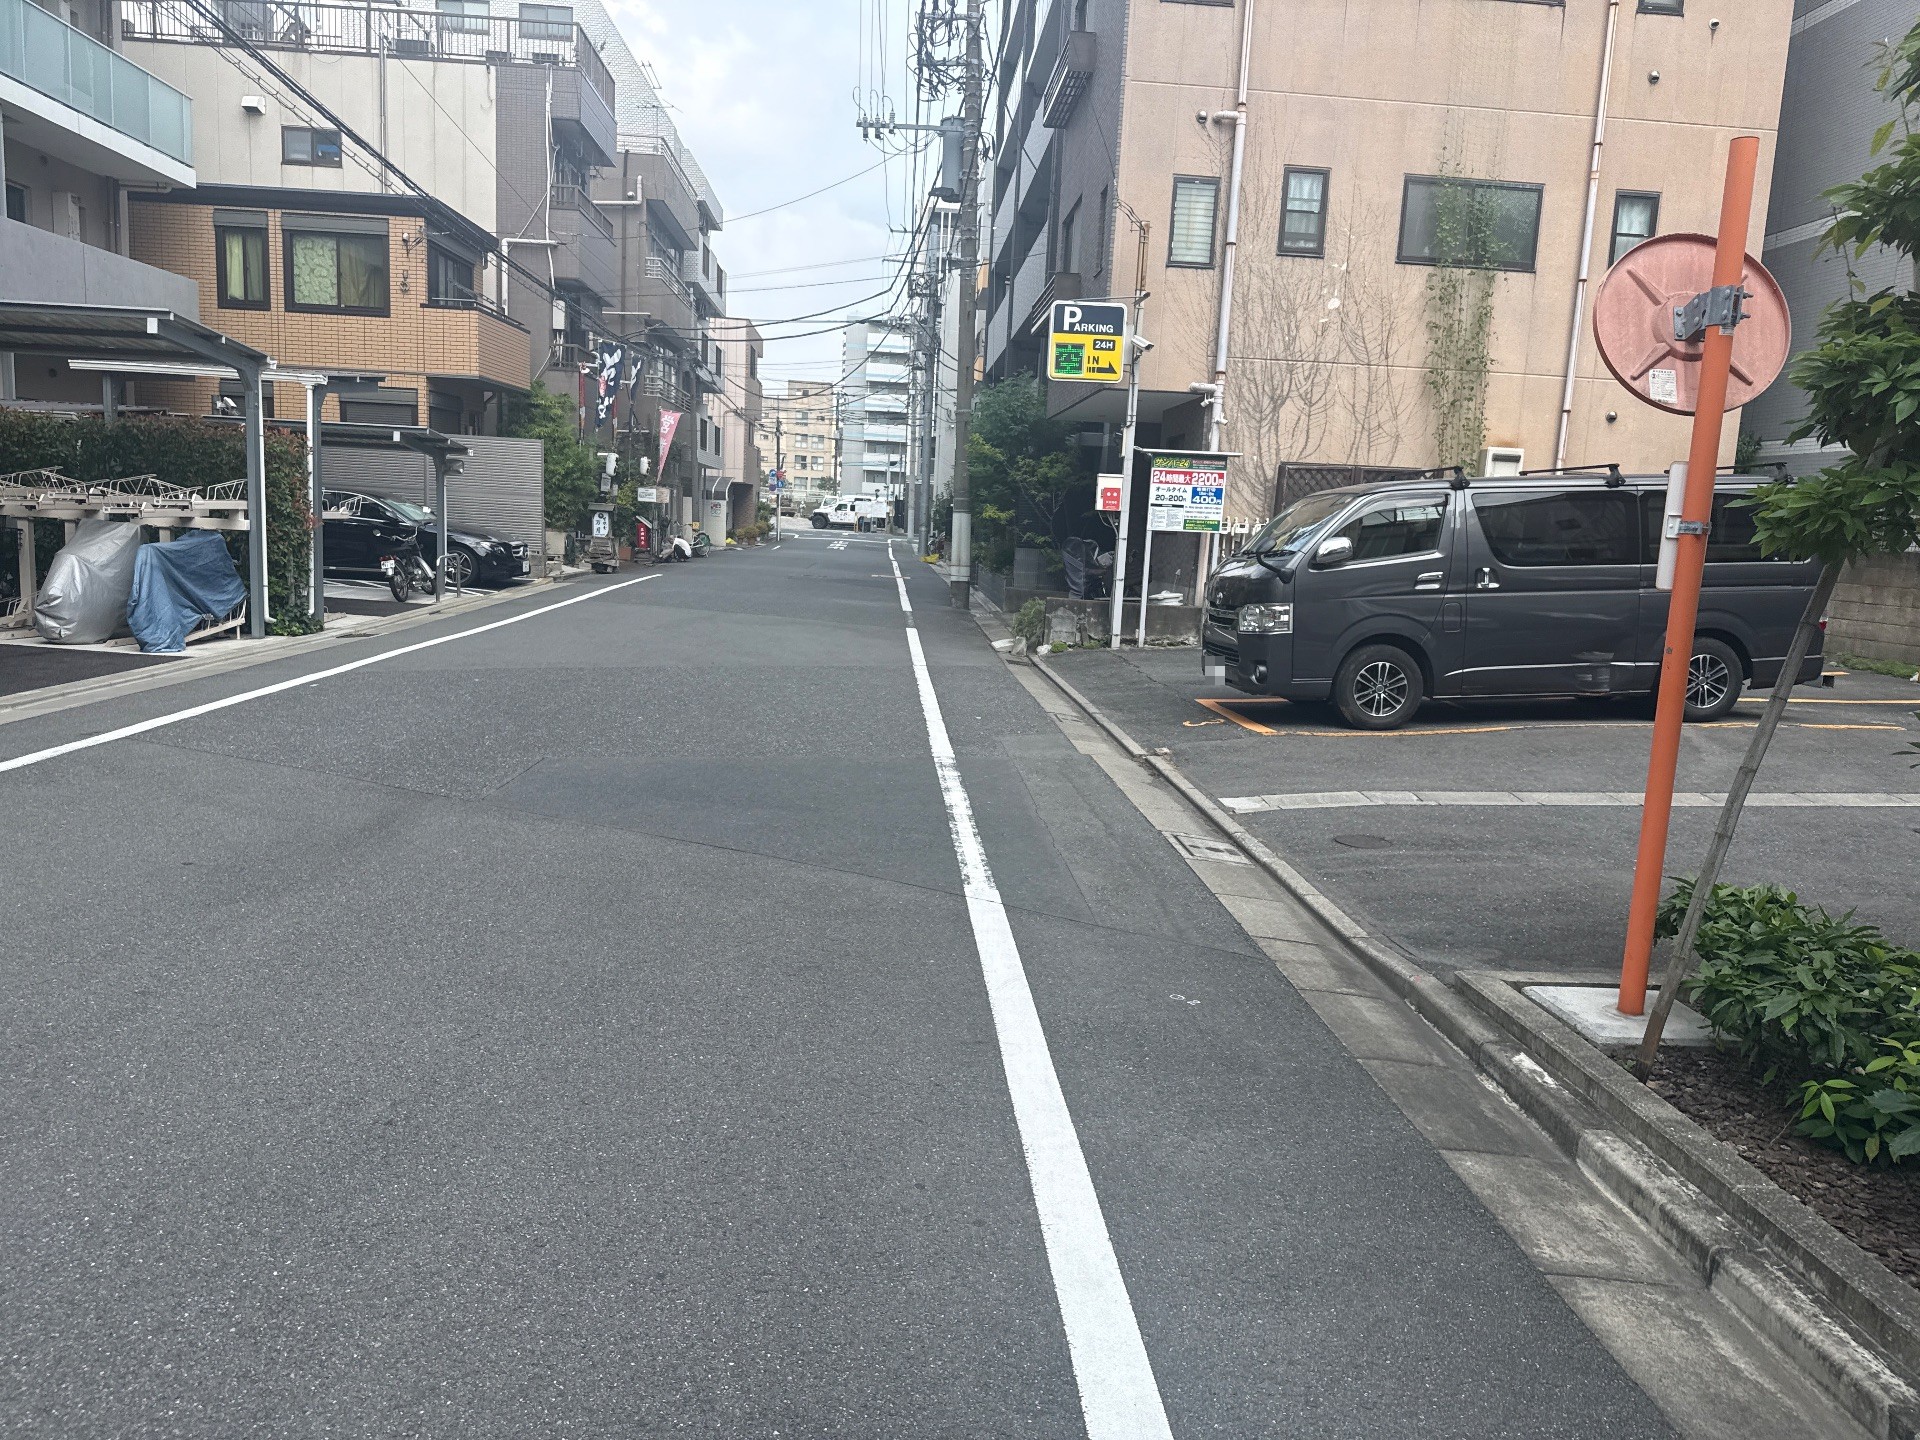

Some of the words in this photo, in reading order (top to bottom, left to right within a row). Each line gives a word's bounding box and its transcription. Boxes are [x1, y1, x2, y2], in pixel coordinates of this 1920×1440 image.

[1063, 306, 1114, 333] PARKING
[1095, 341, 1113, 349] 24H
[1087, 356, 1099, 365] IN
[1155, 486, 1188, 494] オールタイム
[1192, 496, 1222, 504] 400円
